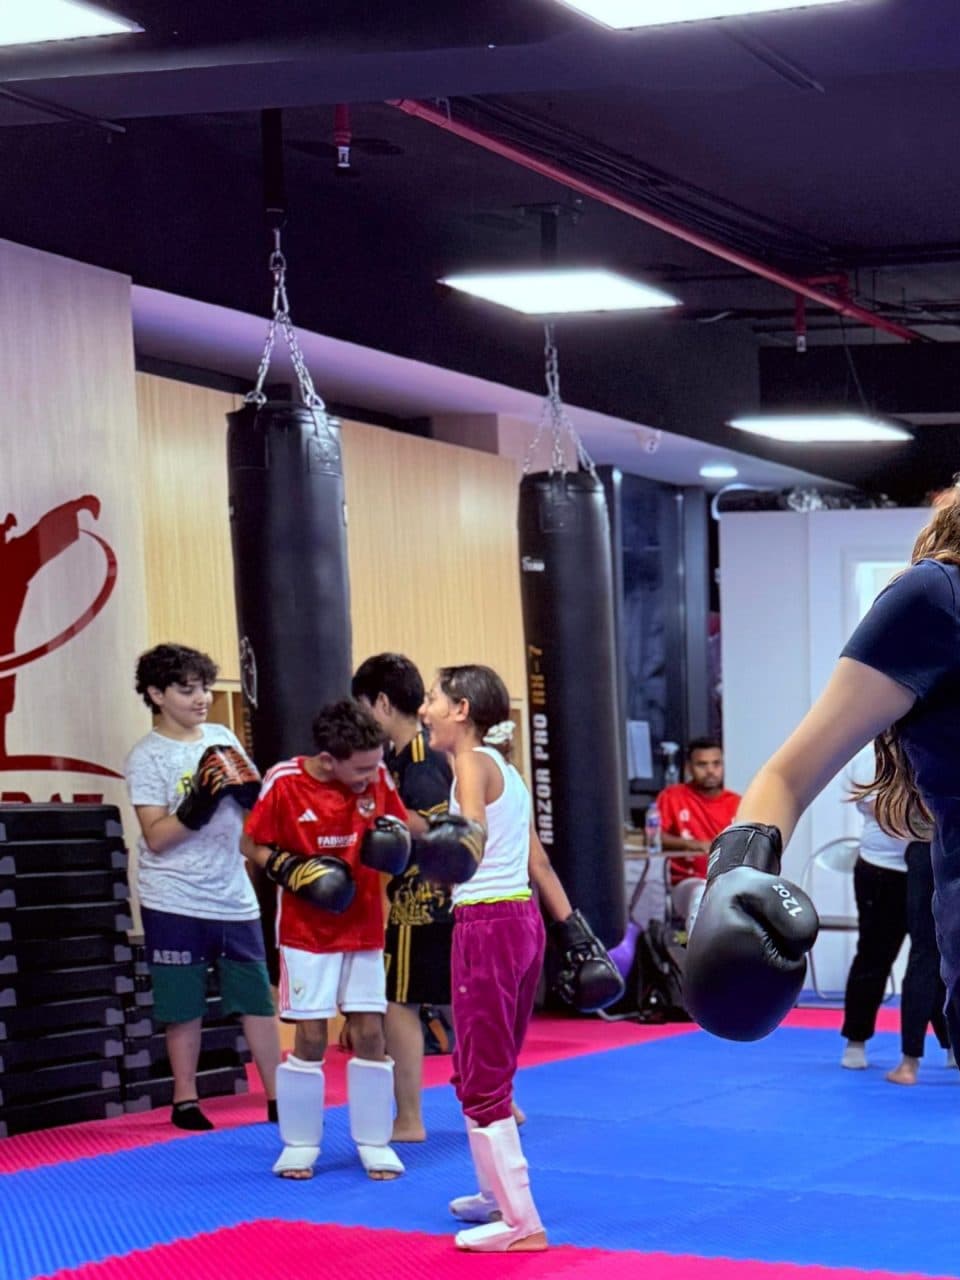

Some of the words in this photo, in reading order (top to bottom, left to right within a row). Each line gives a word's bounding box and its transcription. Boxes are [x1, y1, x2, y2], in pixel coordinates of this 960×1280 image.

[533, 713, 549, 761] PRO
[772, 883, 803, 917] 12oz
[153, 949, 192, 965] AERO
